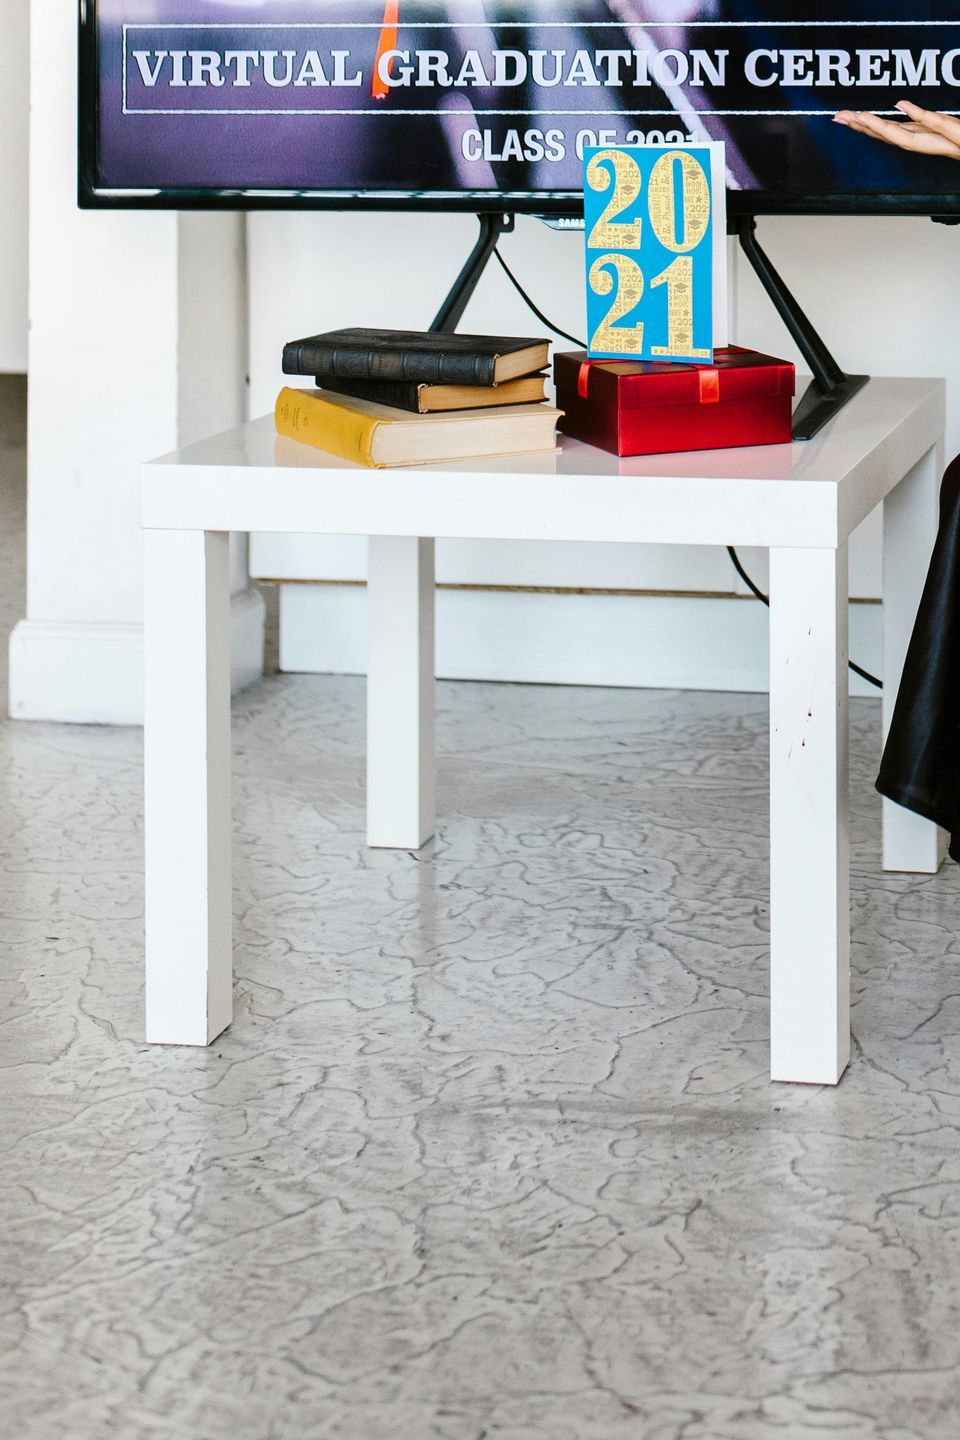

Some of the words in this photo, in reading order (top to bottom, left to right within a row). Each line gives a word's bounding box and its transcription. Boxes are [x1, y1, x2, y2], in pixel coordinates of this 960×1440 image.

[132, 49, 363, 87] VIRTUAL
[377, 48, 730, 87] GRADUATION
[461, 128, 566, 162] CLASS
[586, 149, 710, 252] 20
[587, 252, 711, 358] 21
